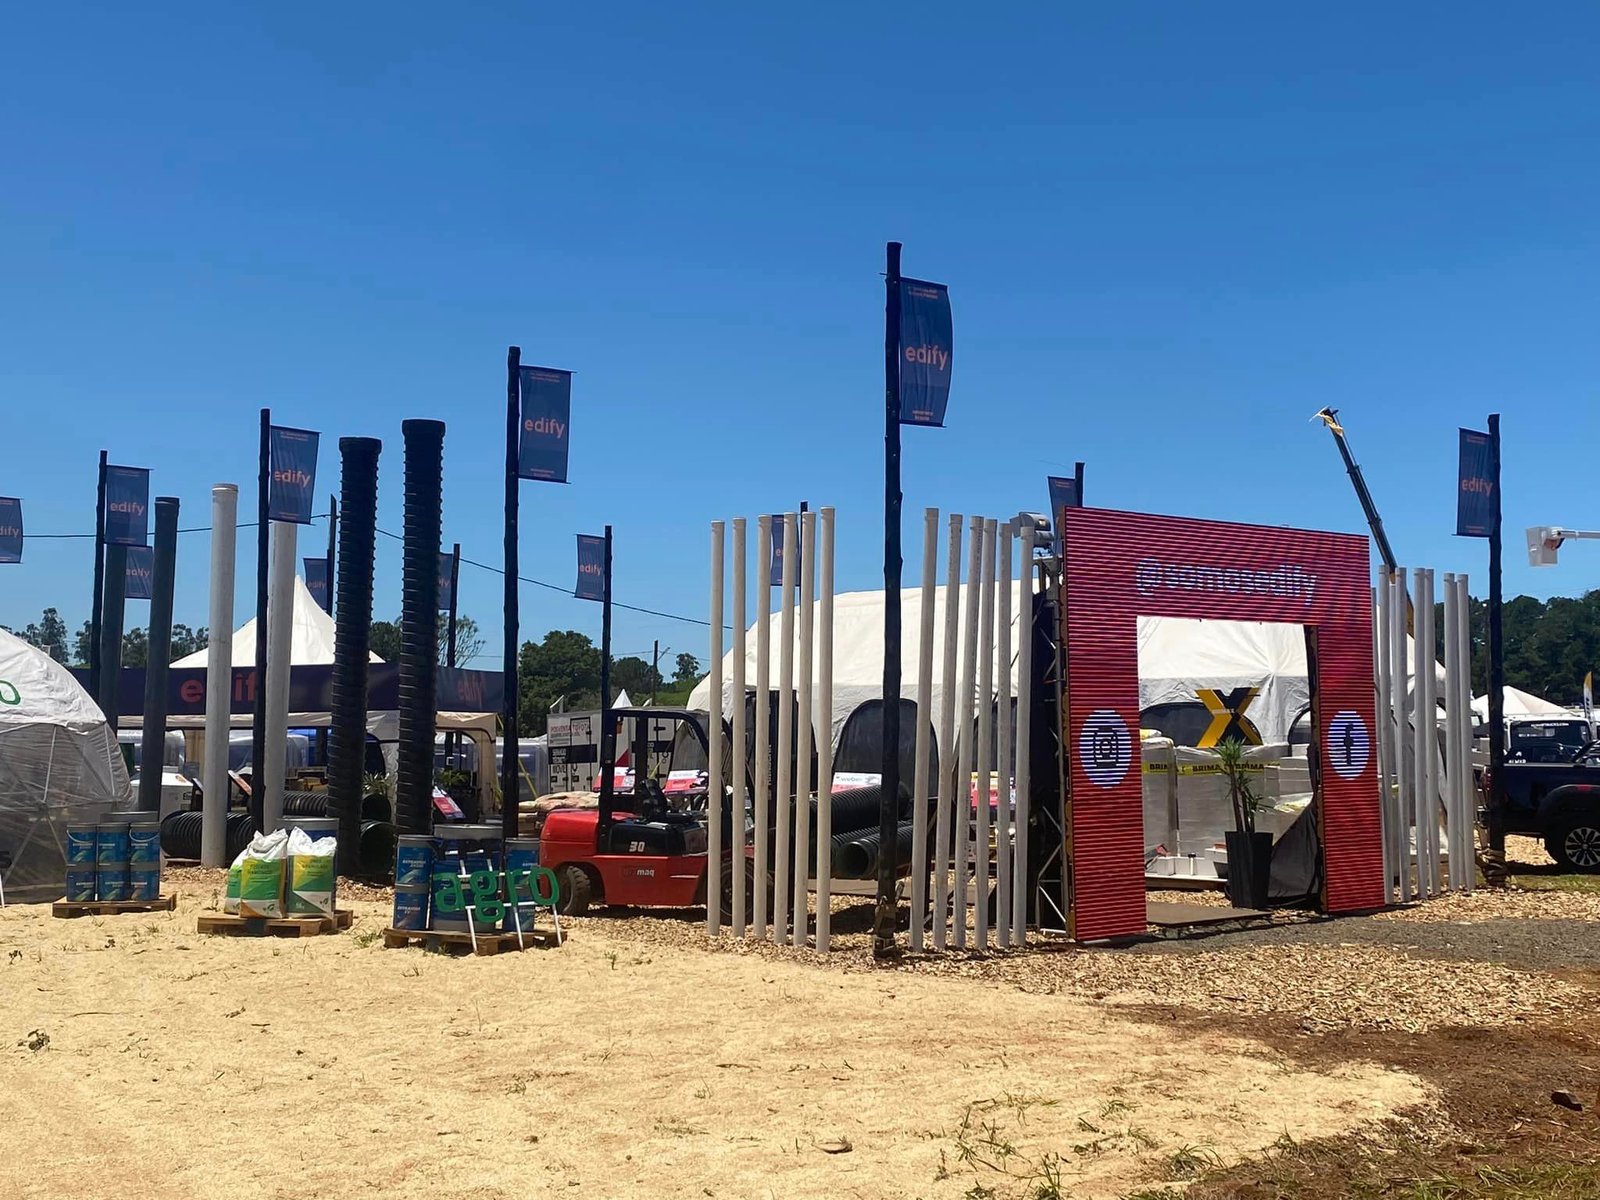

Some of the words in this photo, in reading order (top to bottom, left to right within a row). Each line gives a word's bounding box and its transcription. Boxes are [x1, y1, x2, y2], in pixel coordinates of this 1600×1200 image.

[904, 344, 948, 371] edify
[524, 416, 566, 439] edify
[274, 468, 311, 488] edify
[1461, 476, 1493, 497] edify
[109, 501, 145, 516] edify
[0, 526, 20, 538] dify
[579, 562, 602, 577] edify
[628, 841, 646, 853] 30
[433, 866, 560, 923] agro
